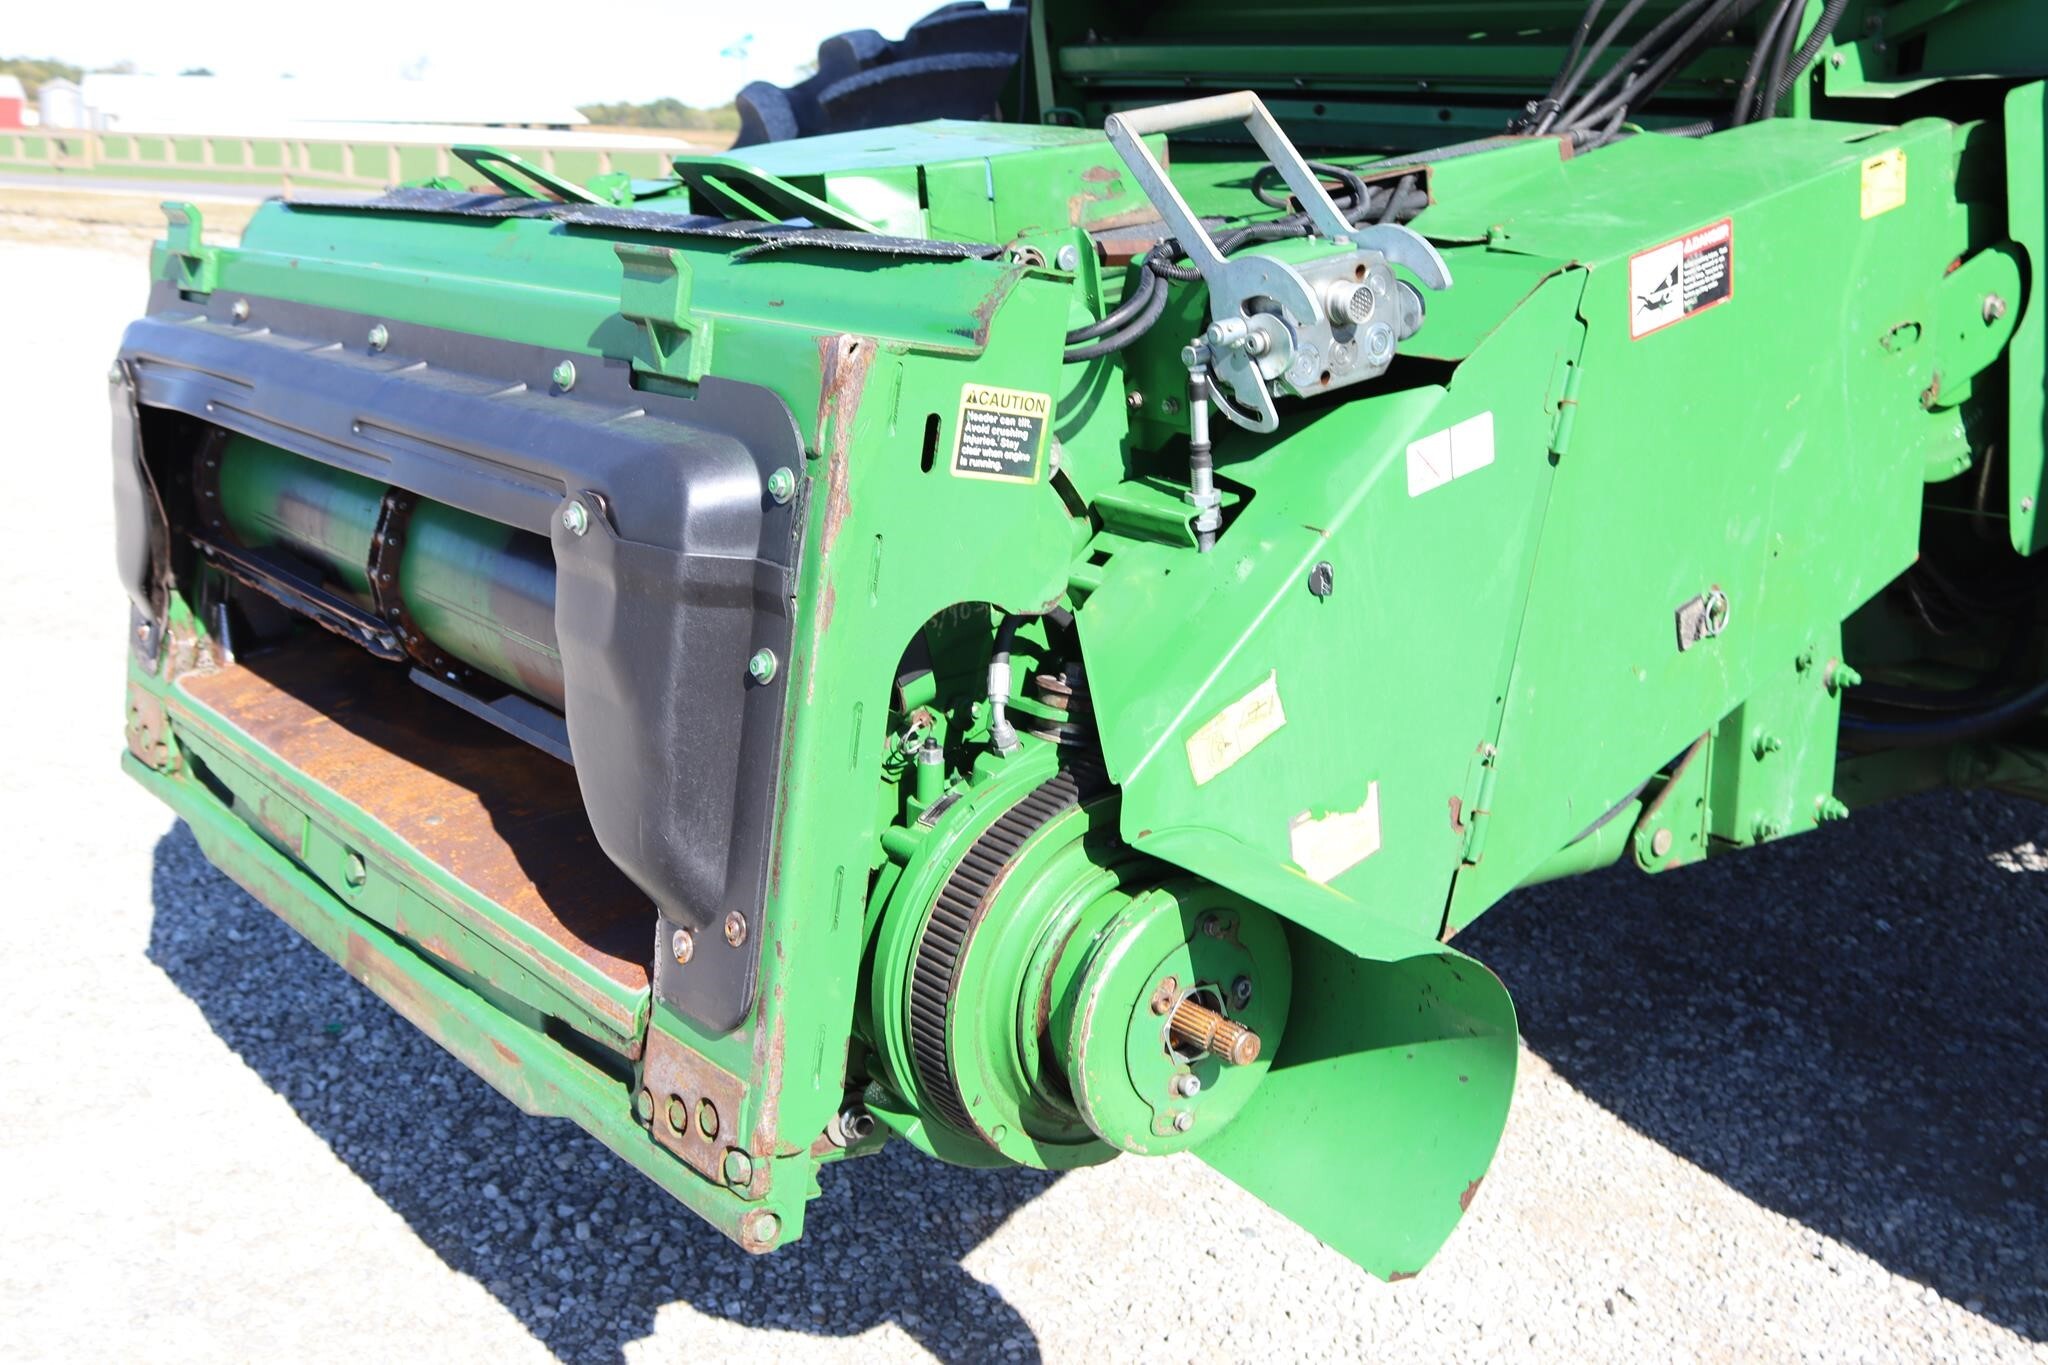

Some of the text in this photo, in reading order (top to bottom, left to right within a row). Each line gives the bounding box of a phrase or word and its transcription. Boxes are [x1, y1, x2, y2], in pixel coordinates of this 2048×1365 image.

[979, 391, 1045, 413] CAUTION
[1000, 416, 1017, 427] can
[1018, 418, 1033, 429] tilt.
[965, 422, 1029, 441] Avoid crushing
[1001, 438, 1020, 451] Stay
[961, 445, 1031, 462] clear when engine
[969, 458, 1003, 472] running.
